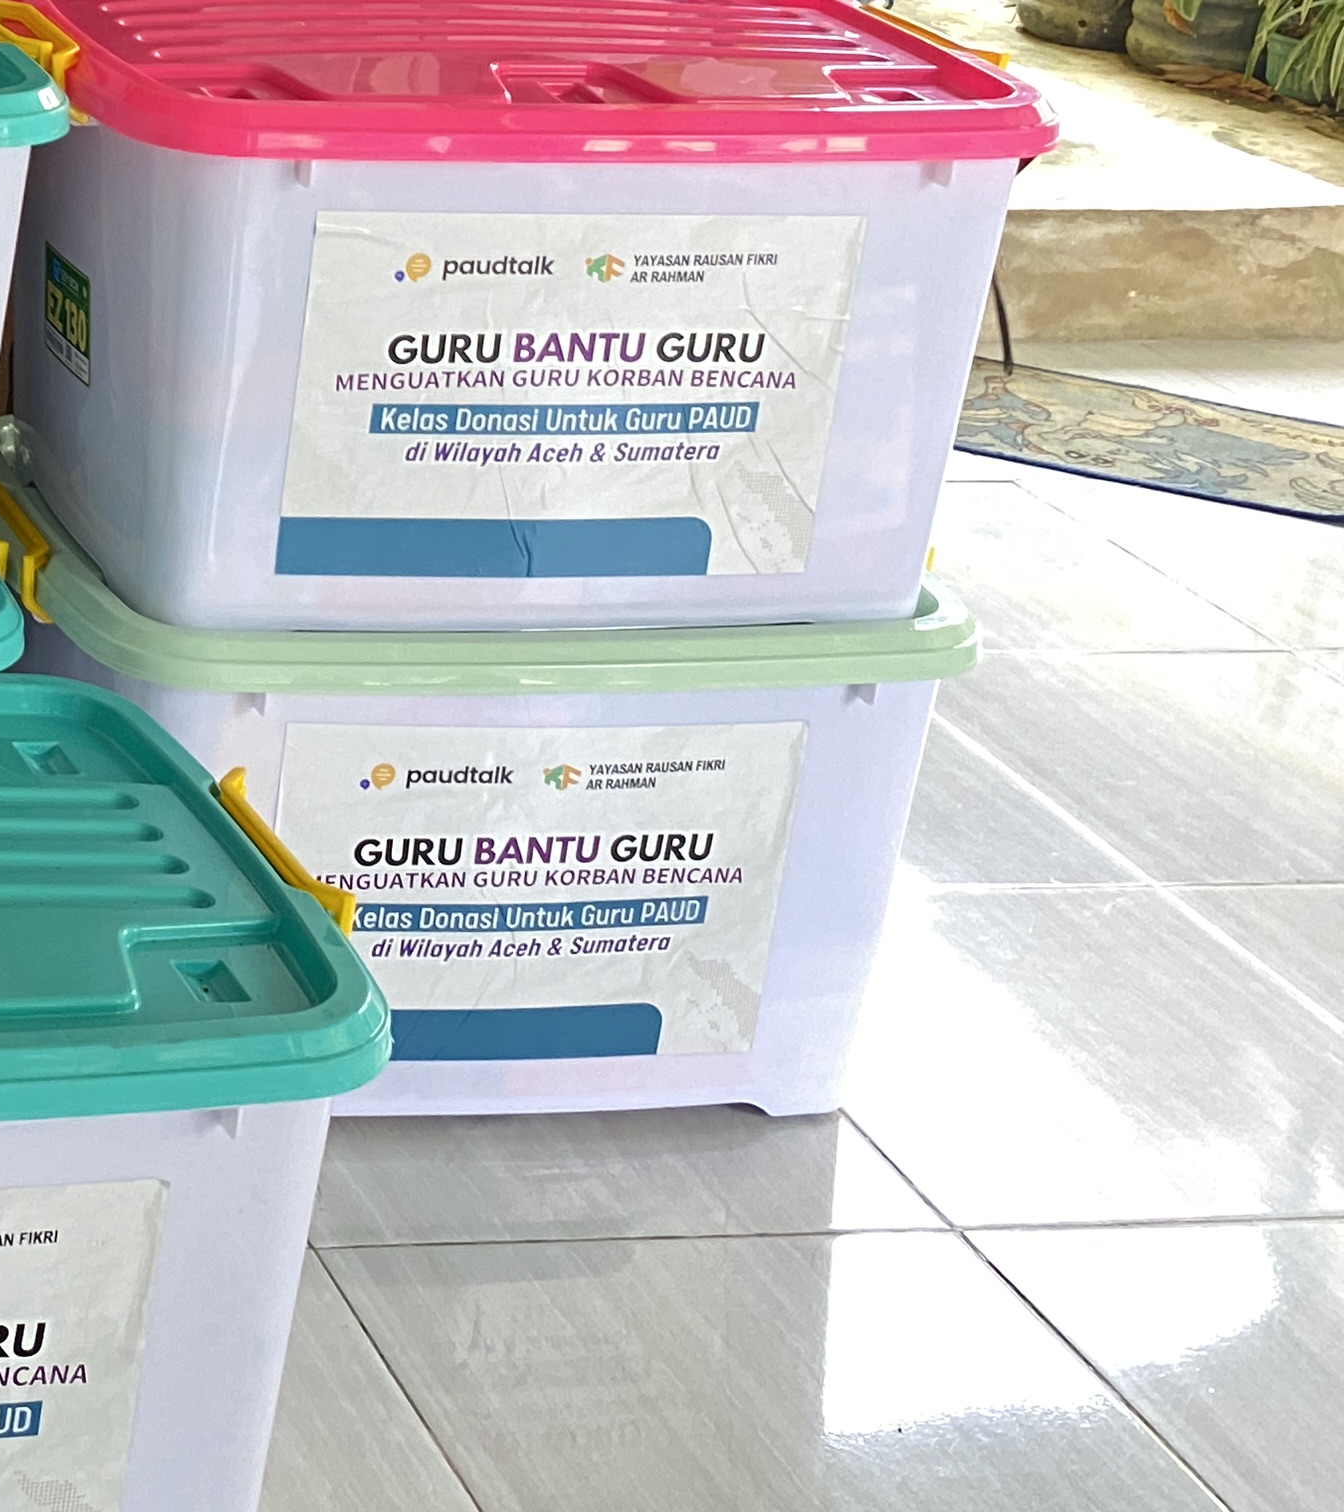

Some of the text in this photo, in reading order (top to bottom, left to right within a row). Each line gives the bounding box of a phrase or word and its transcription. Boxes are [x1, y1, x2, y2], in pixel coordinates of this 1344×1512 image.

[443, 255, 554, 280] paudtalk
[388, 332, 765, 365] GURU BANTU GURU
[405, 767, 514, 789] paudtalk
[354, 833, 714, 867] GURU BANTU GURU
[19, 1230, 59, 1247] FIKRI
